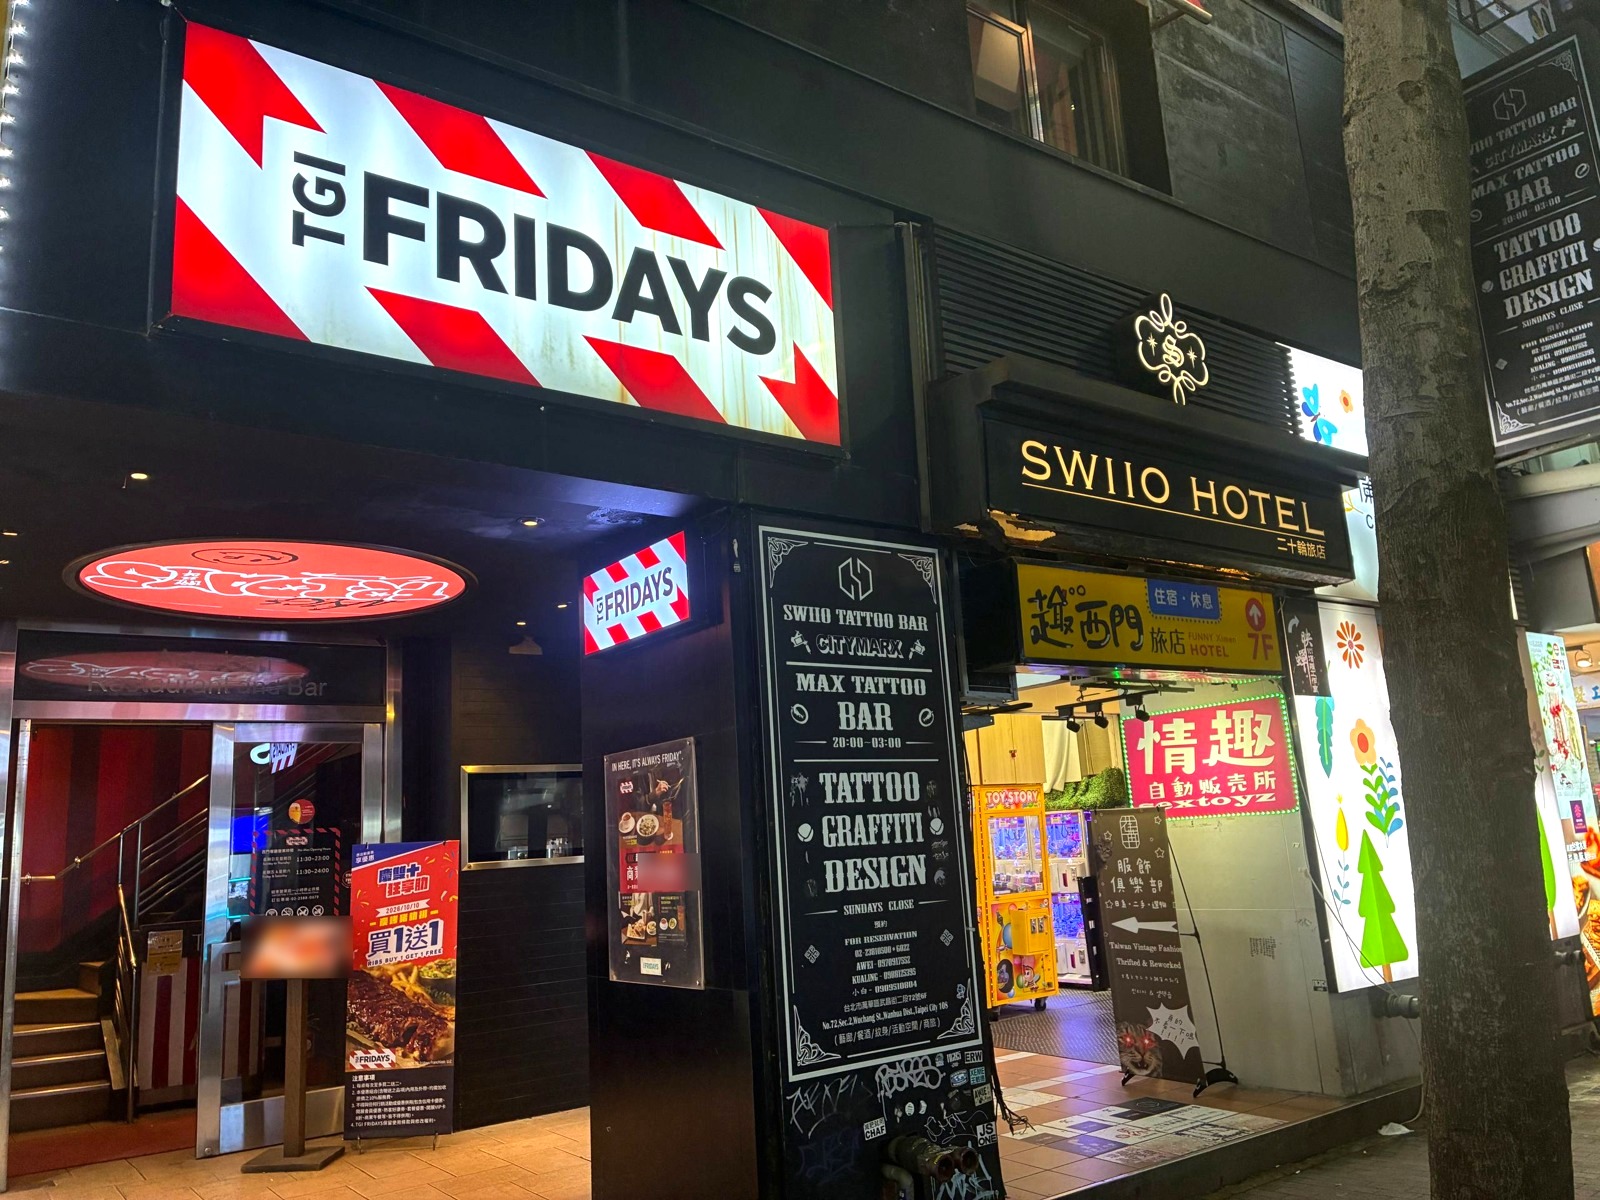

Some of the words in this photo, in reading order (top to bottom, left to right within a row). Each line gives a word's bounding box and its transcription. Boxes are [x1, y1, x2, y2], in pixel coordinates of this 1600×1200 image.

[1496, 111, 1546, 142] TATTOO
[1549, 96, 1578, 119] BAR
[1471, 173, 1508, 200] MAX
[1513, 142, 1580, 181] TATTOO
[1504, 176, 1553, 212] BAR
[1493, 212, 1582, 263] TATTOO
[292, 151, 346, 247] TGI
[363, 171, 776, 355] FRIDAYS
[1499, 240, 1589, 291] GRAFFITI
[1503, 268, 1594, 320] DESIGN
[1522, 311, 1556, 328] SUNDAYS
[1560, 301, 1584, 315] CLOSE
[1521, 341, 1537, 349] FOR
[1539, 321, 1593, 343] RESERVATION
[1022, 440, 1170, 503] SWIIO
[1191, 476, 1325, 536] HOTEL
[1277, 537, 1326, 559] 二十輪旅店
[595, 597, 604, 625] TGI
[605, 566, 673, 621] FRIDAYS
[783, 604, 831, 624] SWIIO
[836, 609, 894, 629] TATTOO
[898, 614, 928, 631] BAR
[816, 633, 904, 659] CITYMARX
[1150, 627, 1186, 655] 旅店
[1188, 632, 1213, 642] FUNNY
[1248, 633, 1274, 660] 7F
[1190, 644, 1229, 658] HOTEL
[288, 677, 328, 697] Bar
[796, 673, 845, 693] MAX
[851, 675, 927, 696] TATTOO
[837, 701, 893, 731] BAR
[1137, 710, 1275, 774] 情趣
[611, 763, 617, 771] IN
[642, 754, 661, 767] ALWAYS
[819, 771, 920, 804] TATTOO
[986, 792, 1005, 803] TOY
[1008, 790, 1038, 803] STORY
[1149, 771, 1276, 799] 自動販売所
[822, 812, 924, 848] GRAFFITI
[824, 854, 926, 893] DESIGN
[1117, 857, 1151, 874] 服飾
[1111, 877, 1163, 894] 俱樂部
[843, 901, 883, 917] SUNDAYS
[888, 899, 914, 911] CLOSE
[367, 920, 440, 958] 買1送1
[845, 937, 862, 946] FOR
[864, 930, 918, 943] RESERVATION
[1109, 941, 1131, 950] Taiwan
[1133, 943, 1157, 953] Vintage
[367, 957, 382, 967] RIBS
[405, 952, 419, 960] GET
[425, 948, 442, 957] FREE
[856, 960, 874, 971] AWEI
[1116, 957, 1140, 967] Thrifted
[1149, 960, 1182, 969] Reworked
[852, 972, 879, 985] KUALING
[852, 987, 867, 997] 小白
[359, 1055, 390, 1064] FRIDAYS
[965, 1051, 982, 1063] ERW
[352, 1074, 375, 1082] 注意事項
[865, 1125, 886, 1140] CHAF
[978, 1135, 997, 1146] ONE
[979, 1124, 994, 1136] JS
